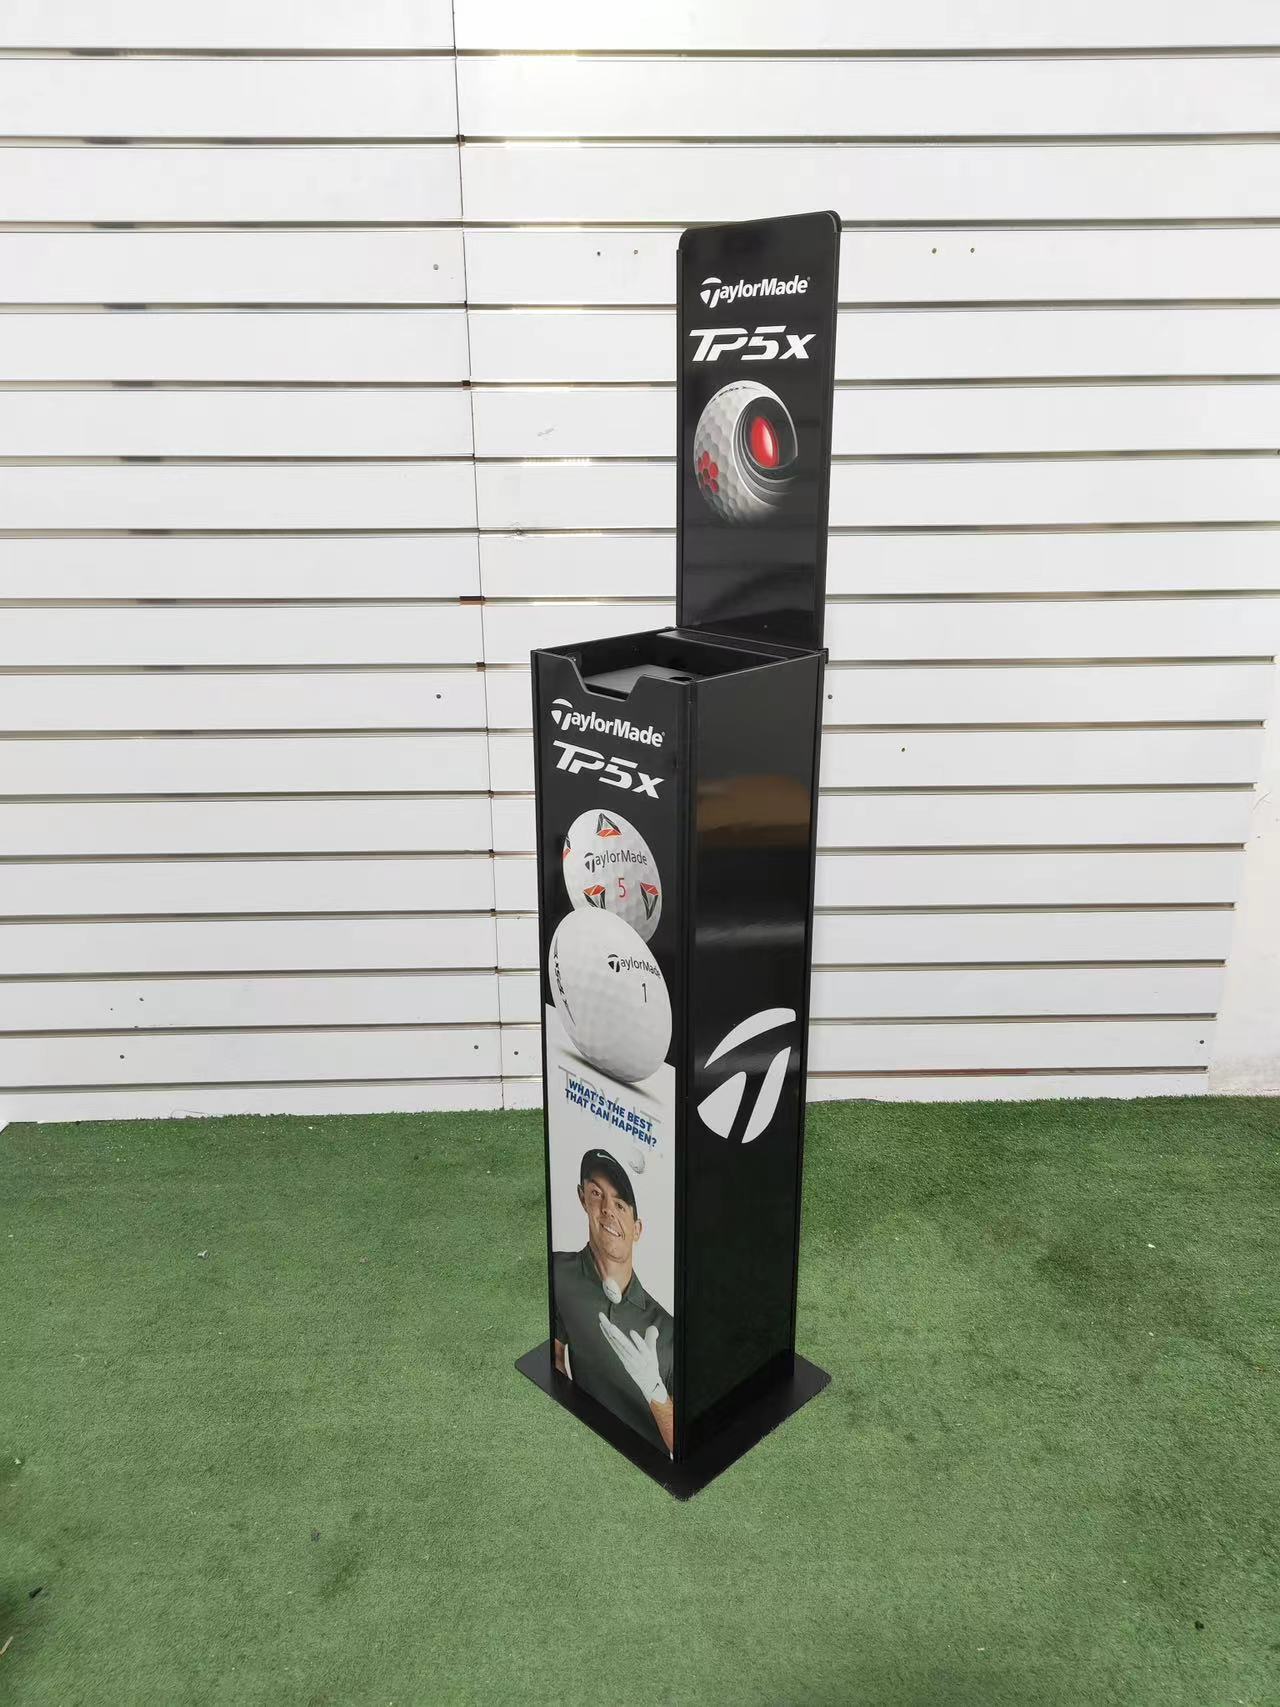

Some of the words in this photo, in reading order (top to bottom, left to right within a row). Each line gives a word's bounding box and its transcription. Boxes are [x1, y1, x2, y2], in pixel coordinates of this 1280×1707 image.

[700, 275, 808, 308] TaylorMade
[689, 325, 817, 362] TP5x
[551, 698, 663, 747] TaylorMade
[552, 740, 665, 799] TP5x
[584, 849, 648, 873] TaylorMade
[618, 877, 626, 898] 5
[641, 982, 647, 1003] 1
[565, 1088, 589, 1108] THAT
[590, 1104, 609, 1121] CAN
[611, 1115, 657, 1147] HAPPEN?
[568, 1078, 605, 1107] WHAT'S
[607, 1099, 625, 1116] THE
[627, 1112, 653, 1132] BEST
